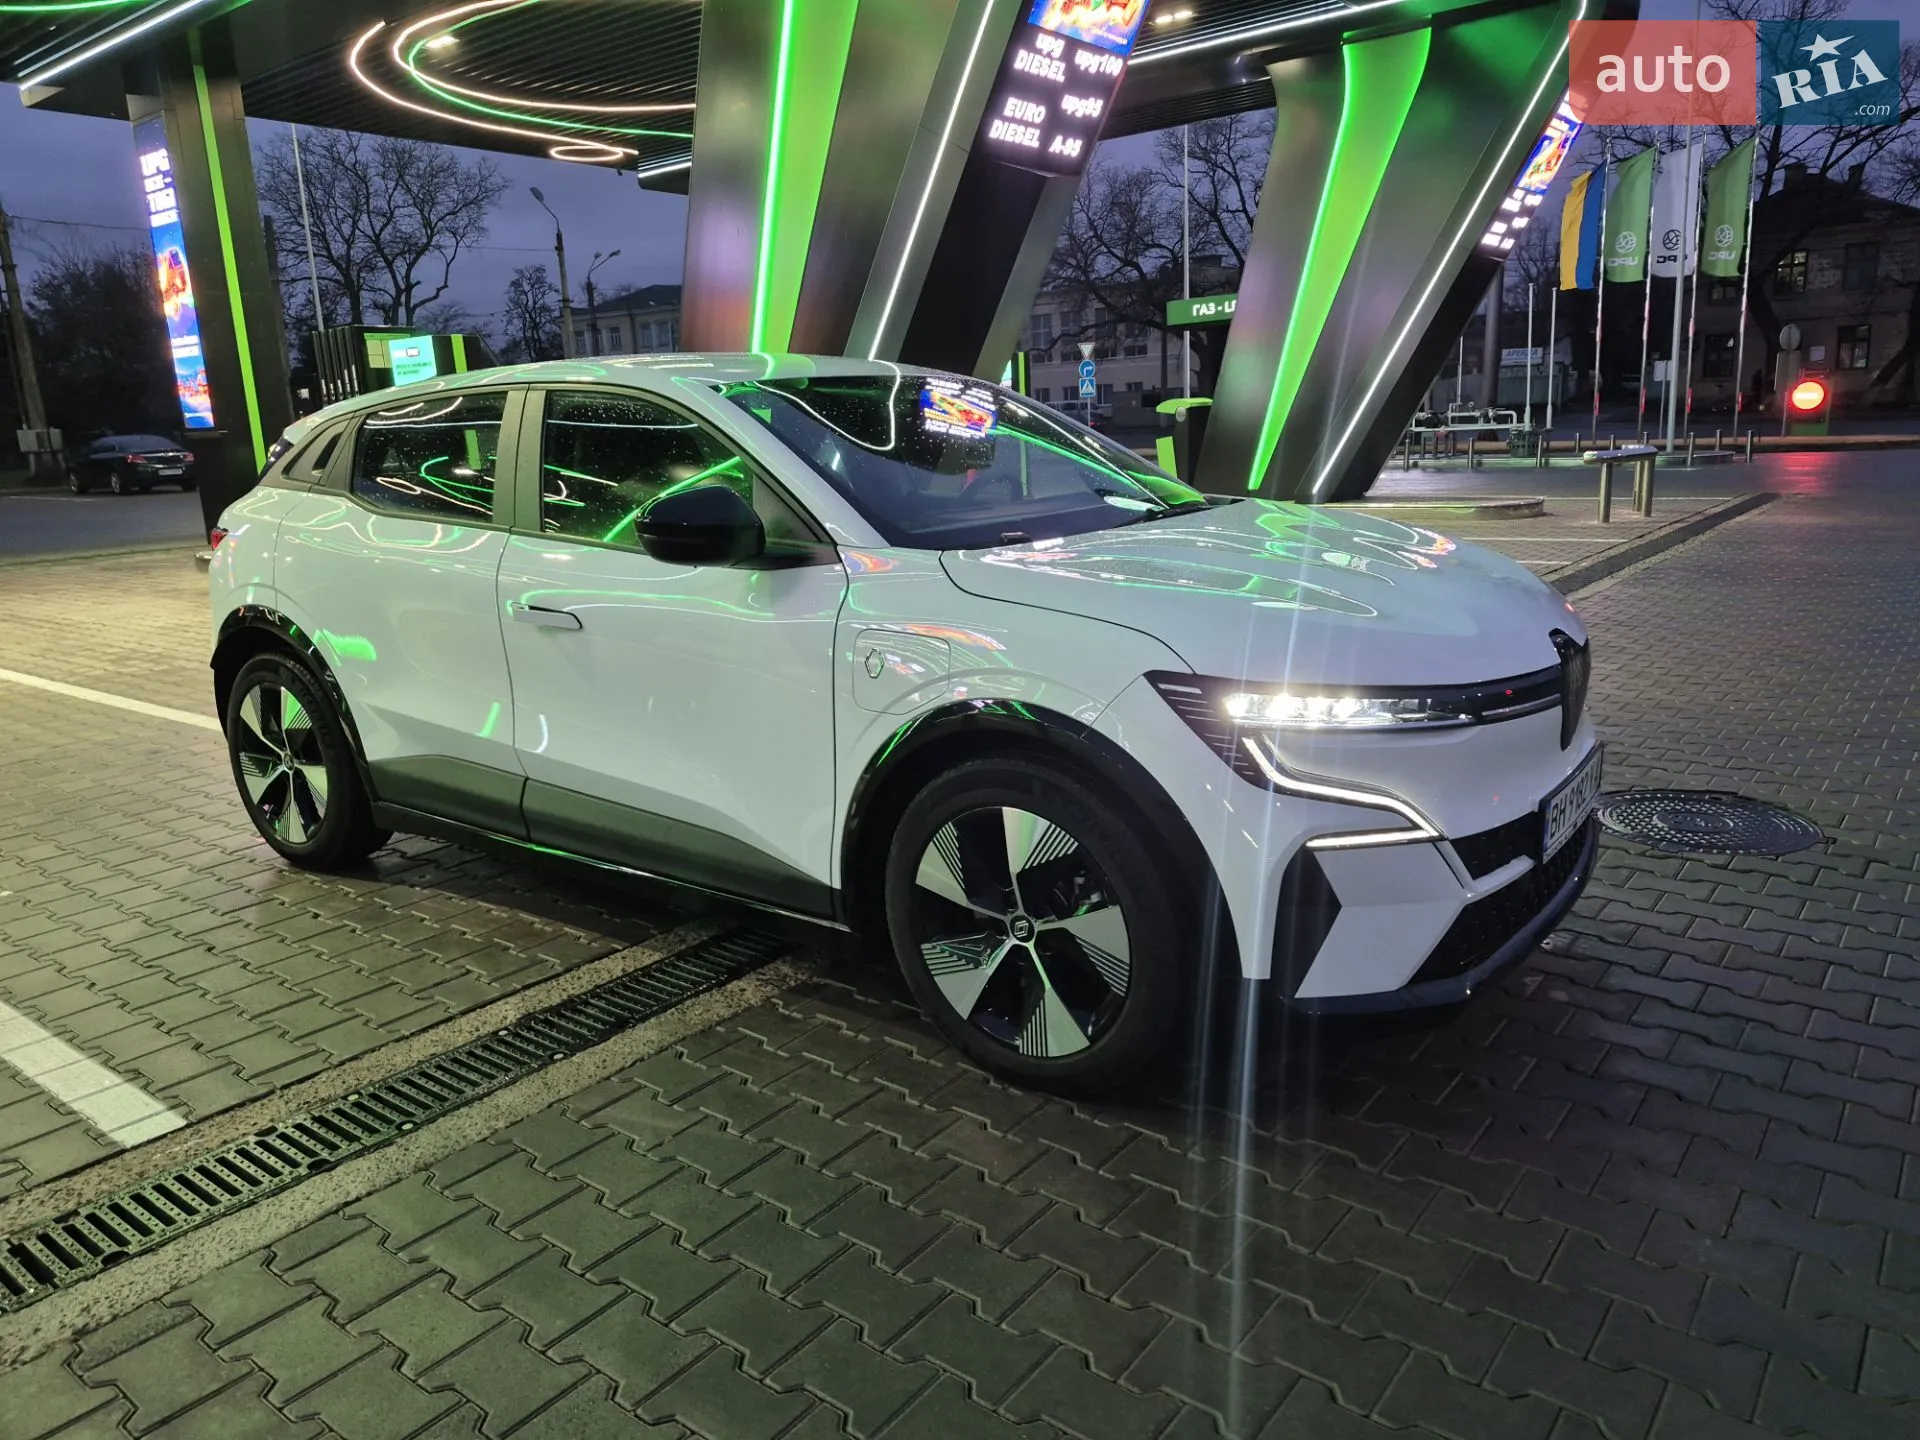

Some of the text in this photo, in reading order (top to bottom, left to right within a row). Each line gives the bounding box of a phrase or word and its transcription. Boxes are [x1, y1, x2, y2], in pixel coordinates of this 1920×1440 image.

[1035, 33, 1065, 59] upg
[1013, 49, 1066, 83] DIESEL
[1074, 49, 1124, 77] upg100
[1003, 96, 1046, 125] EURO
[989, 119, 1041, 148] DIESEL
[1192, 302, 1216, 317] ГАЗ
